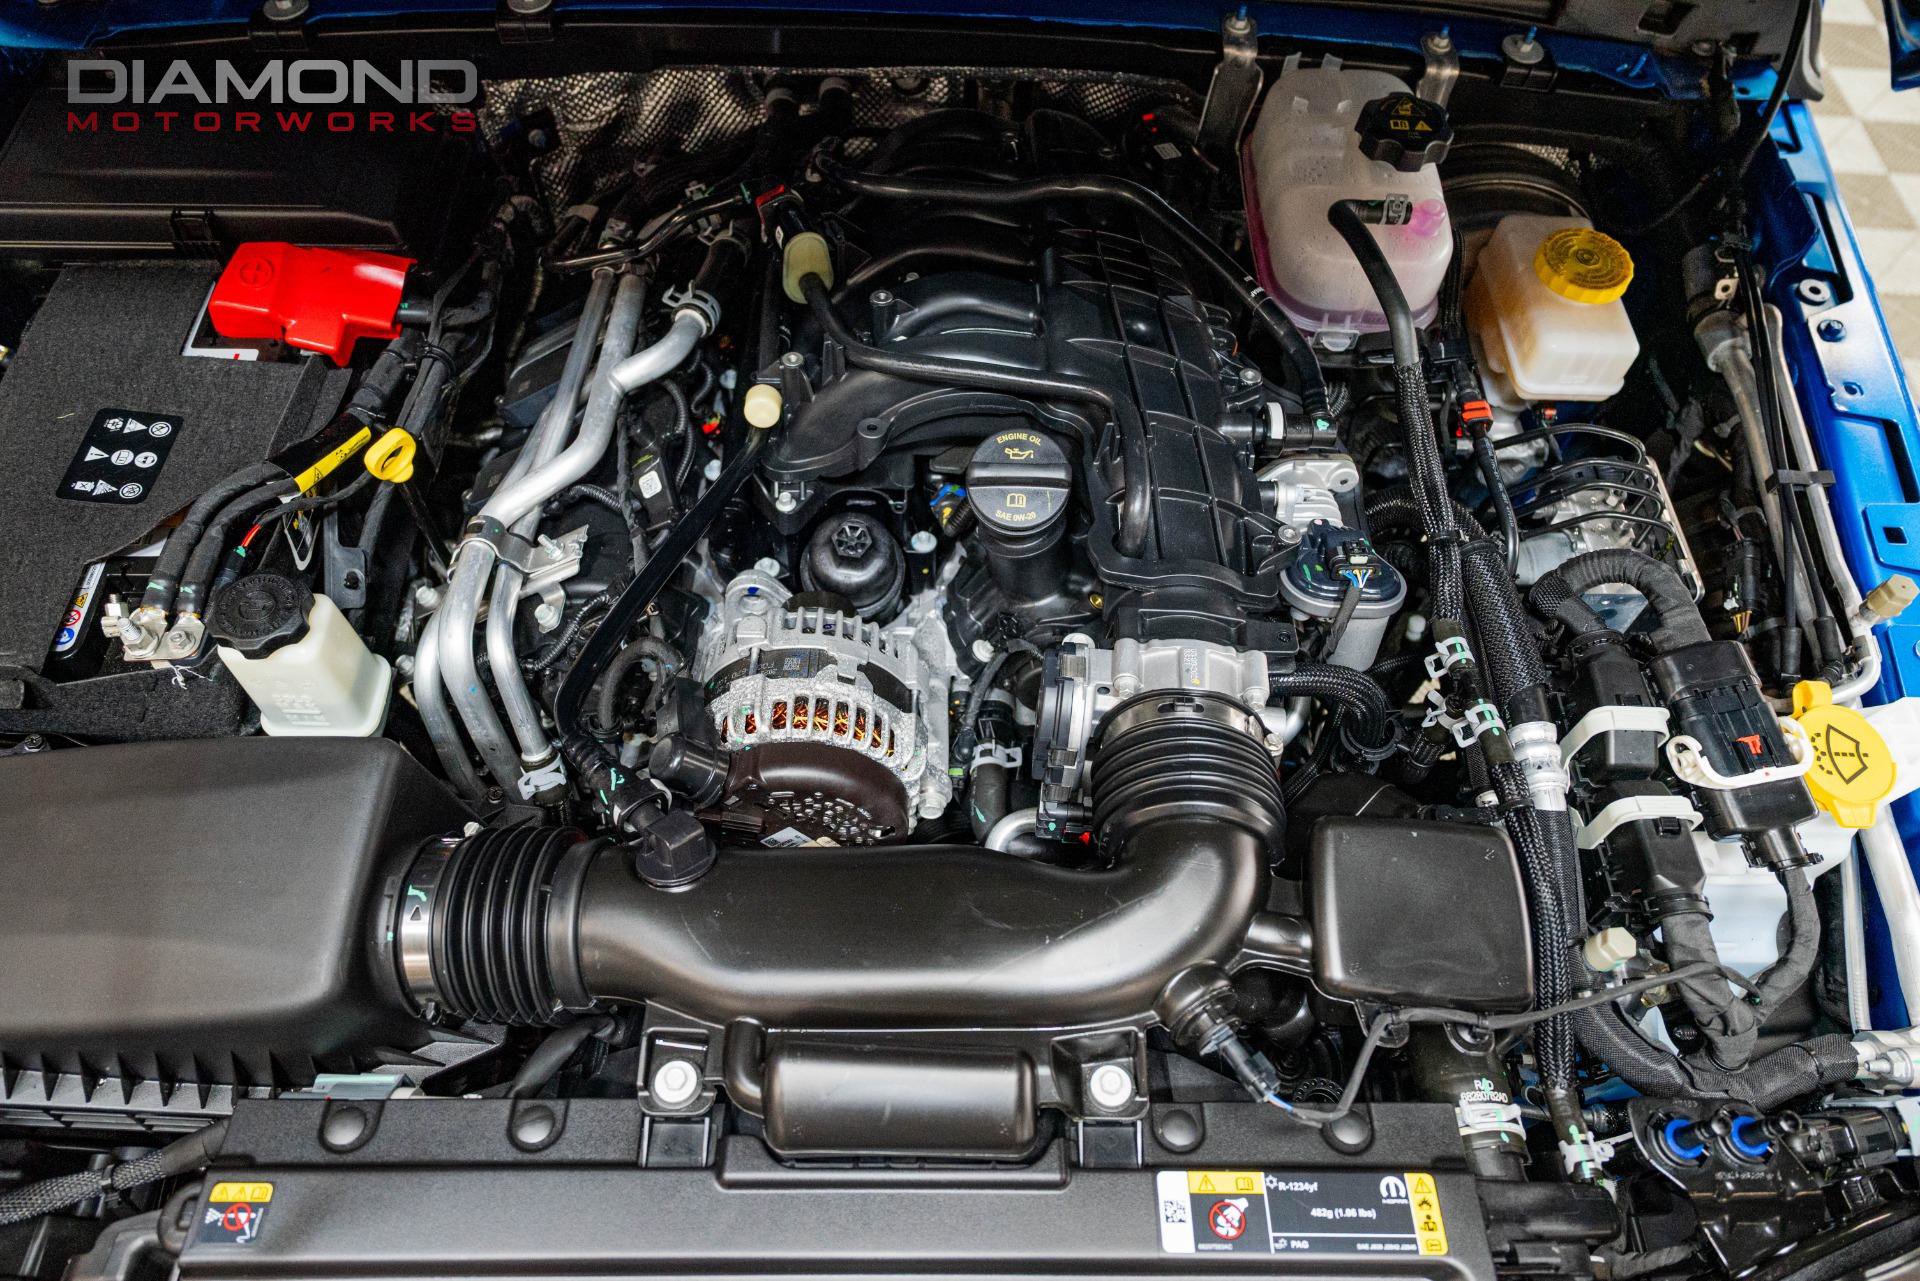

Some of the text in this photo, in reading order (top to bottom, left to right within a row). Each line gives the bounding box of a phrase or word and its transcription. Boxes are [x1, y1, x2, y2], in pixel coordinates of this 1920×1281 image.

[996, 432, 1041, 445] ENGINE OIL
[995, 509, 1037, 522] SAE 0W-20
[1278, 1181, 1319, 1194] R-1234yf
